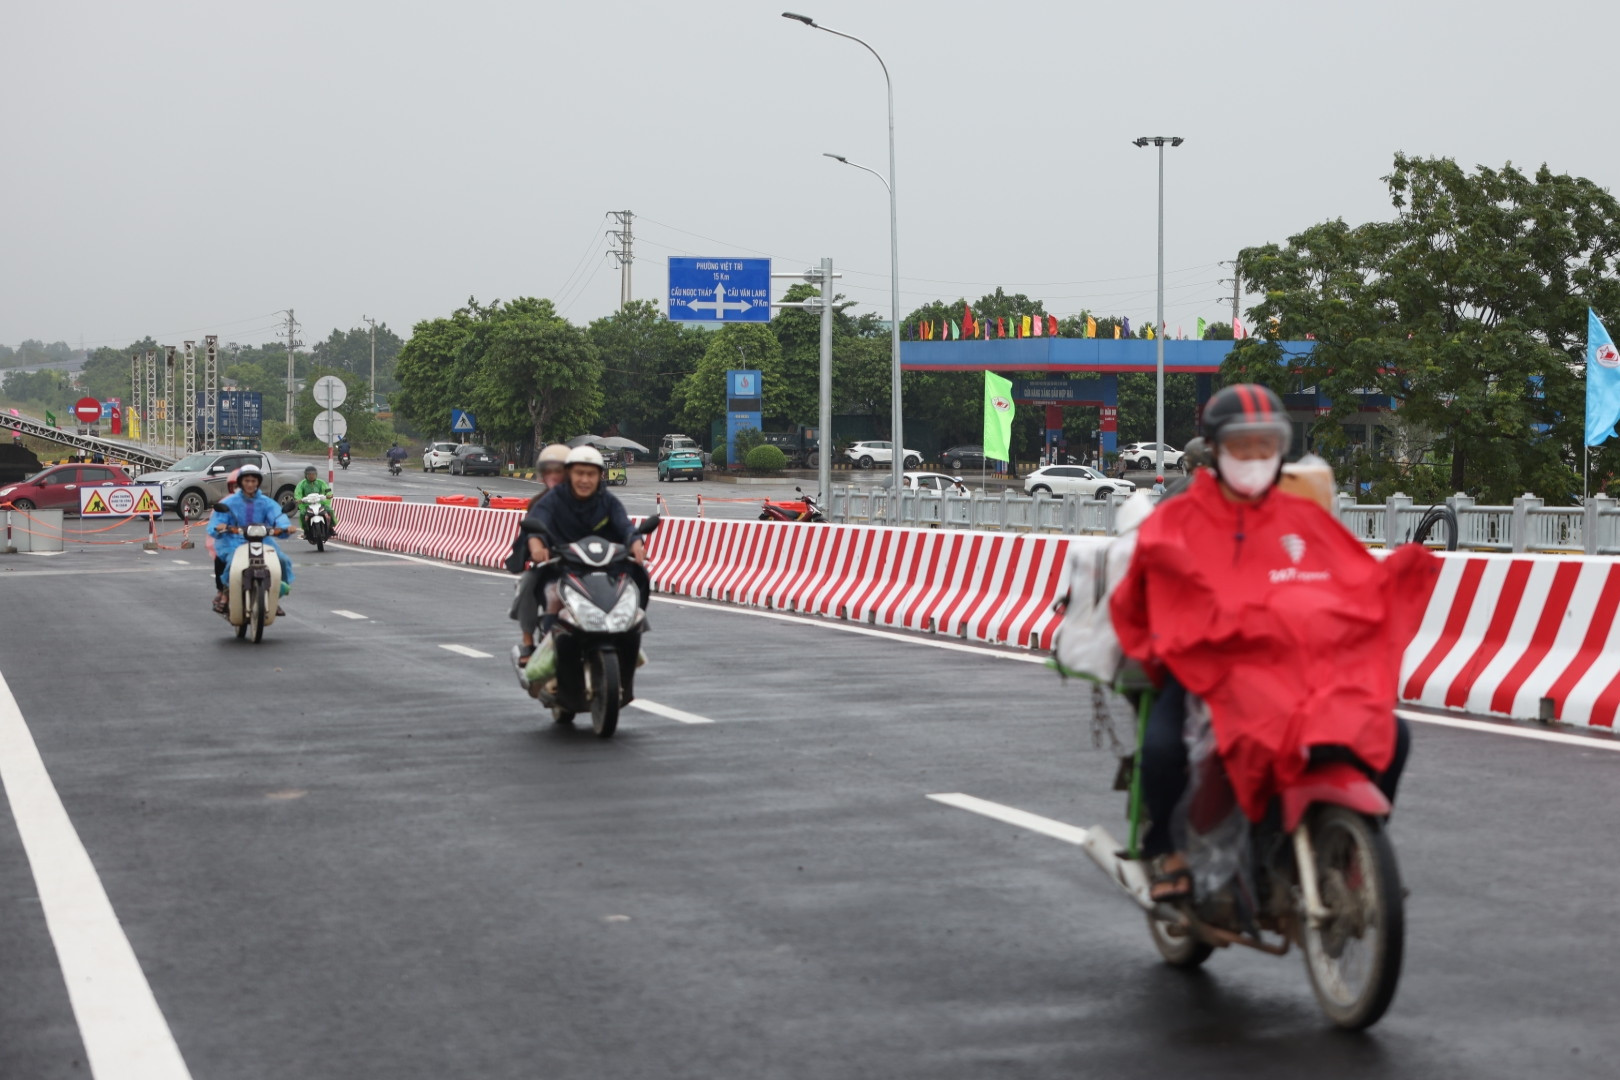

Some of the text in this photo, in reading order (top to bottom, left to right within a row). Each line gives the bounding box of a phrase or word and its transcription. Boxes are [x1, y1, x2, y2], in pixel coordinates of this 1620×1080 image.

[696, 261, 743, 271] PHƯỜNG VIỆT TRÌ
[713, 272, 730, 281] 15 Km
[671, 286, 713, 298] CẦU NGỌC THÁP
[727, 287, 739, 297] CẦU
[751, 289, 767, 297] LANG
[669, 298, 687, 306] 17 Km
[752, 299, 769, 307] 19 Km
